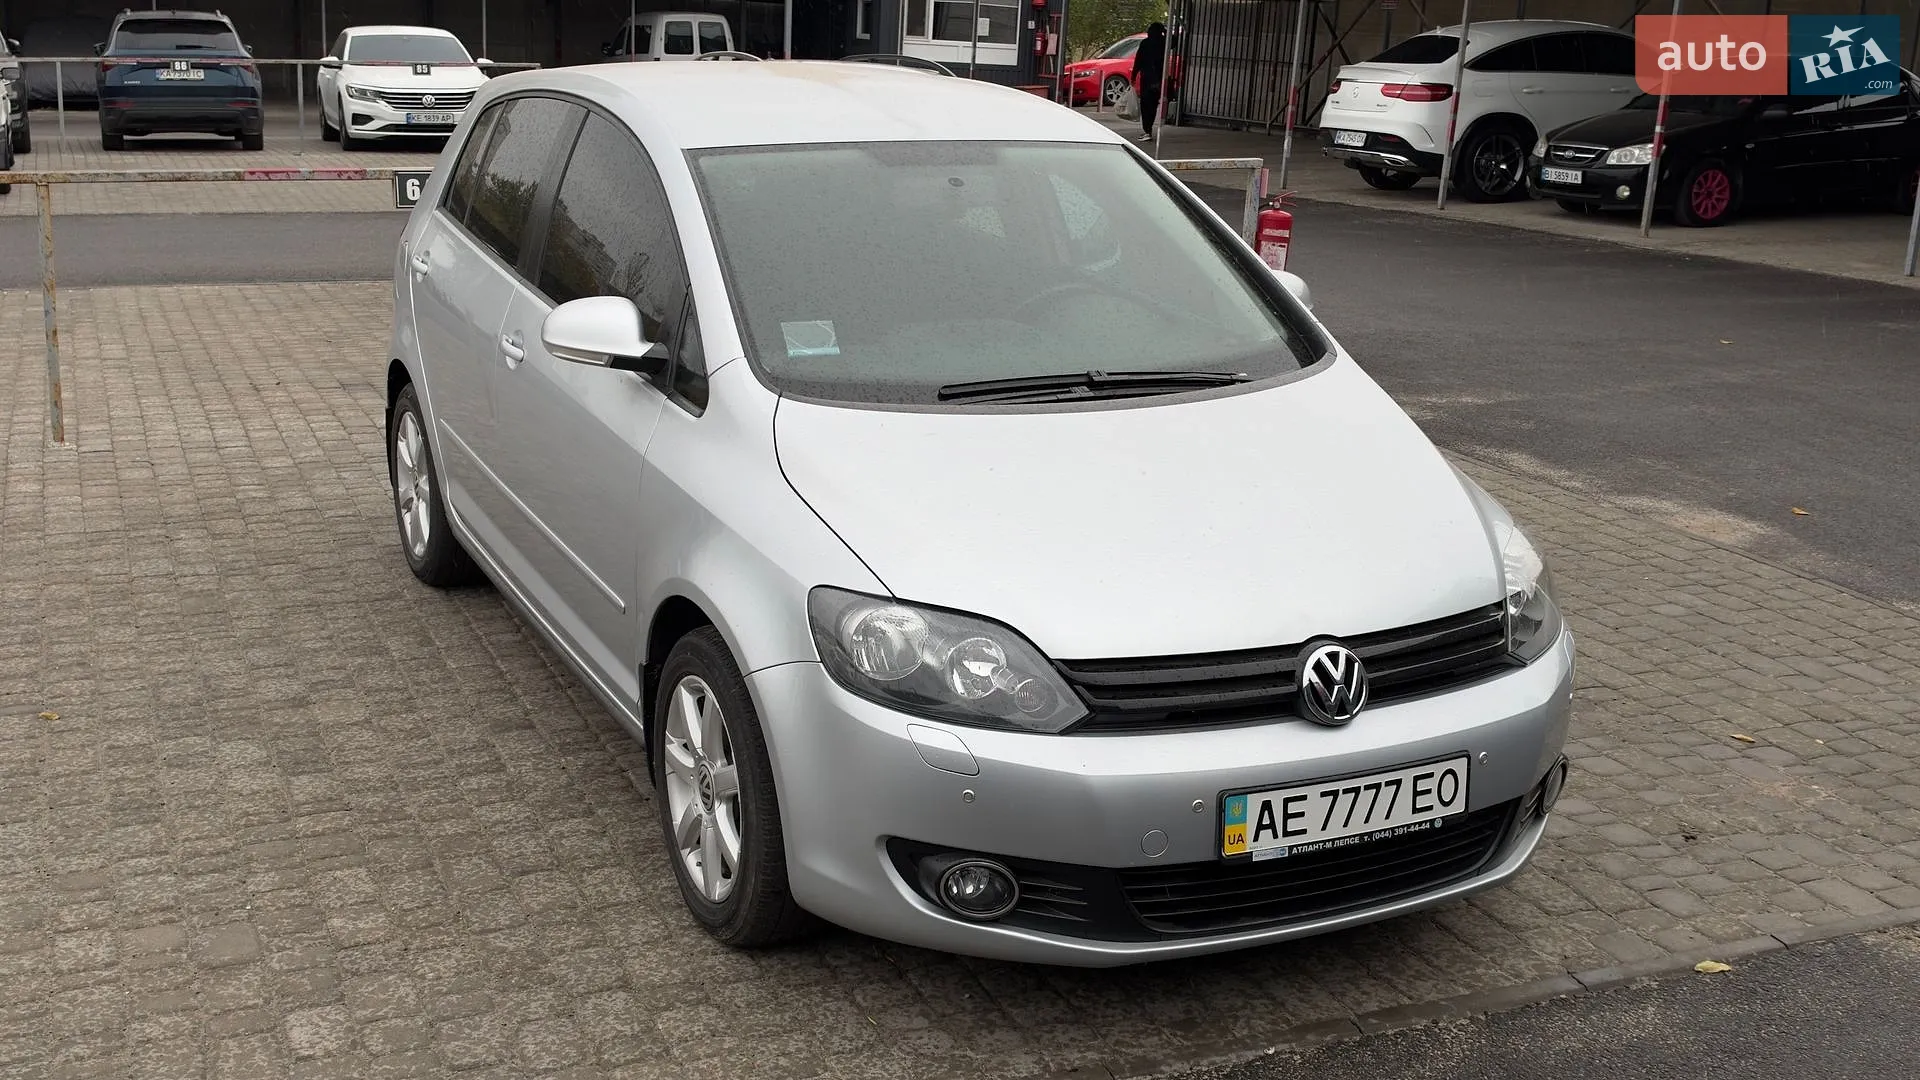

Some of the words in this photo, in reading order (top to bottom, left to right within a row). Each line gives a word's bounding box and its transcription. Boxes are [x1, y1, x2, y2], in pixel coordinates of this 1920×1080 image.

[174, 61, 187, 70] 86
[416, 64, 428, 73] 85
[411, 114, 421, 122] KE
[441, 114, 451, 122] AP
[1253, 794, 1308, 843] AE
[1319, 777, 1403, 831] 7777
[1411, 767, 1459, 815] EO
[1228, 833, 1245, 845] UA
[1333, 836, 1360, 848] ЛЕПСЕ
[1372, 829, 1393, 843] (044)
[1394, 821, 1431, 837] 391-44-44
